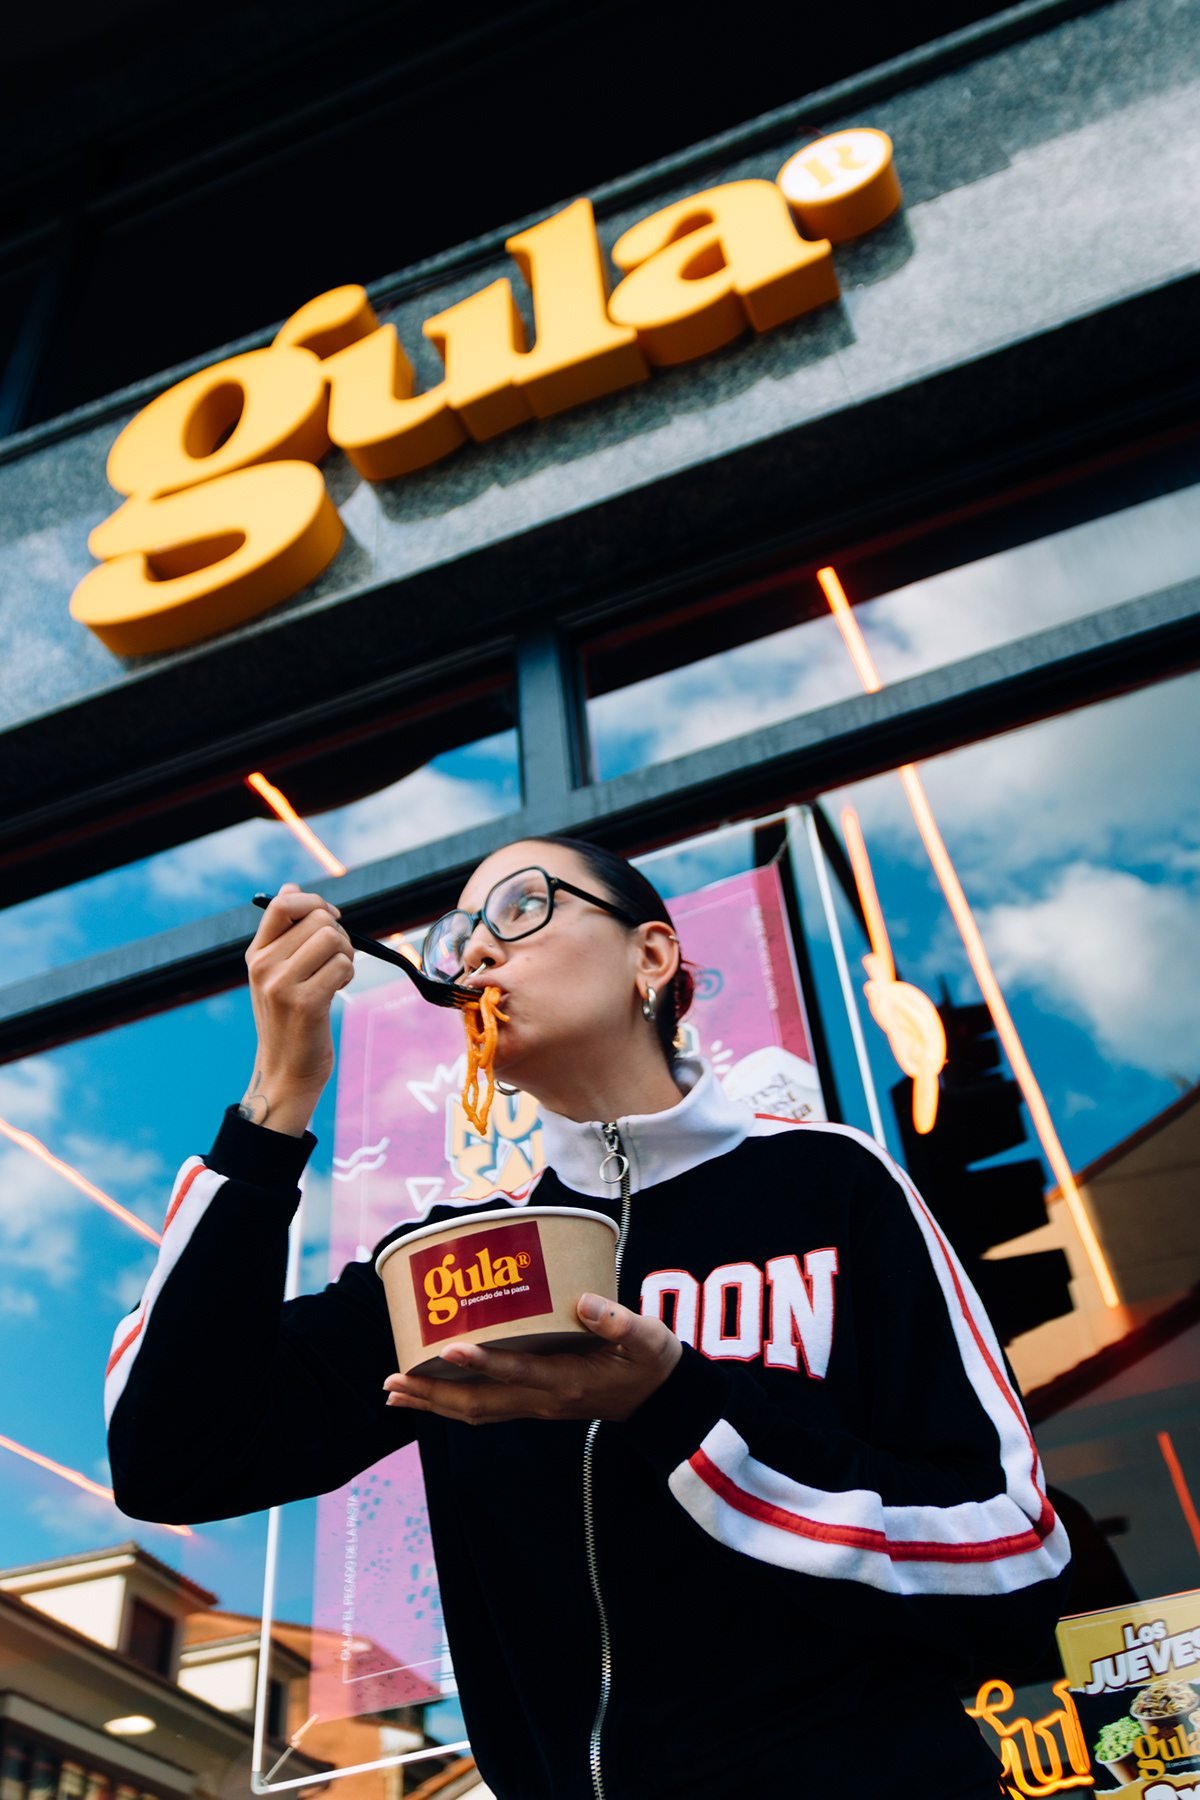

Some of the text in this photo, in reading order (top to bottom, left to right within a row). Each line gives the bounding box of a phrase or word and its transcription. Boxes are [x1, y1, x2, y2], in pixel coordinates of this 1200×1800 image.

[460, 1298, 468, 1307] El
[468, 1293, 493, 1306] pecado
[493, 1290, 503, 1298] de
[511, 1285, 530, 1295] pasta
[343, 1561, 357, 1606] PECADO
